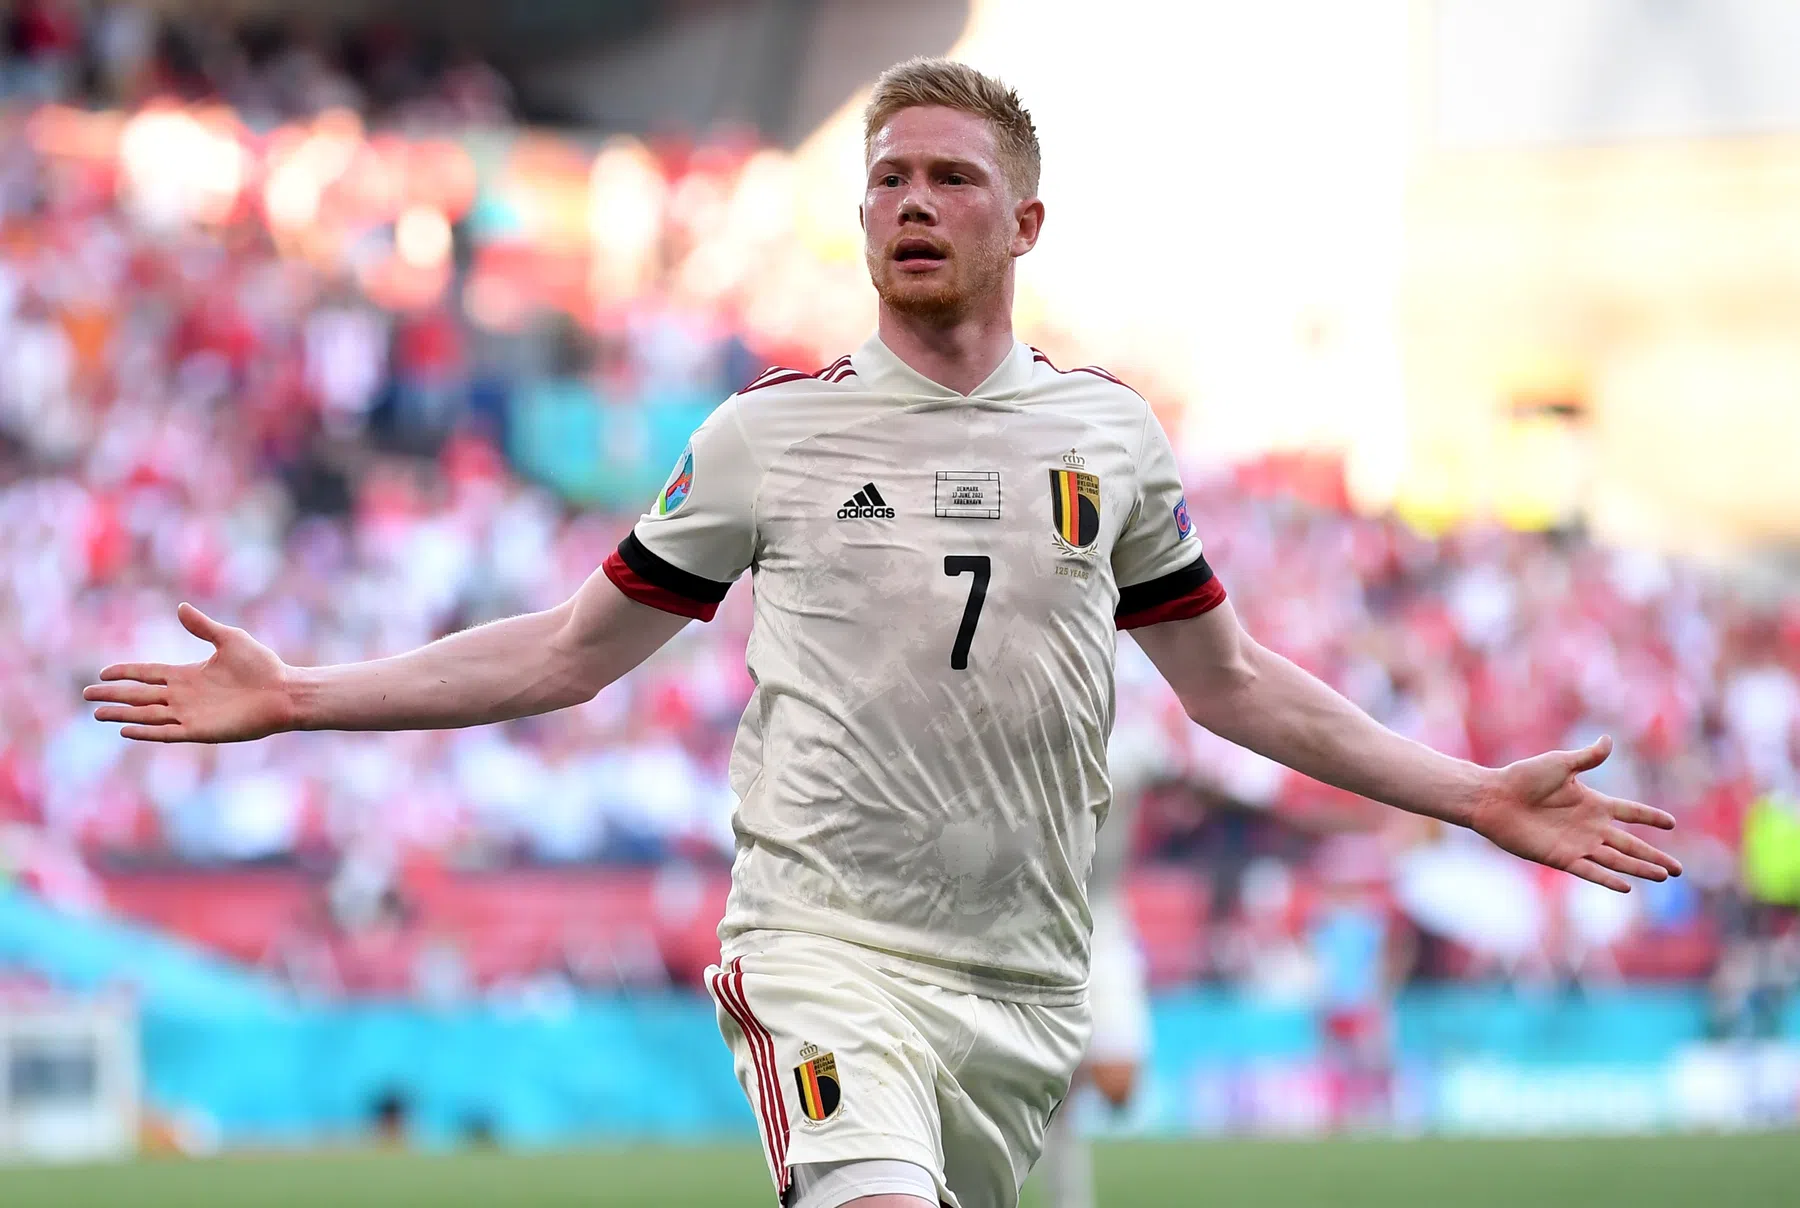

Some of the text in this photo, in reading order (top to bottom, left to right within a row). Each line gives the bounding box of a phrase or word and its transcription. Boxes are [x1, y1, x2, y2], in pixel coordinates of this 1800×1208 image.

[836, 504, 896, 519] adidas
[1055, 566, 1089, 580] 125 YEARS
[944, 556, 991, 670] 7
